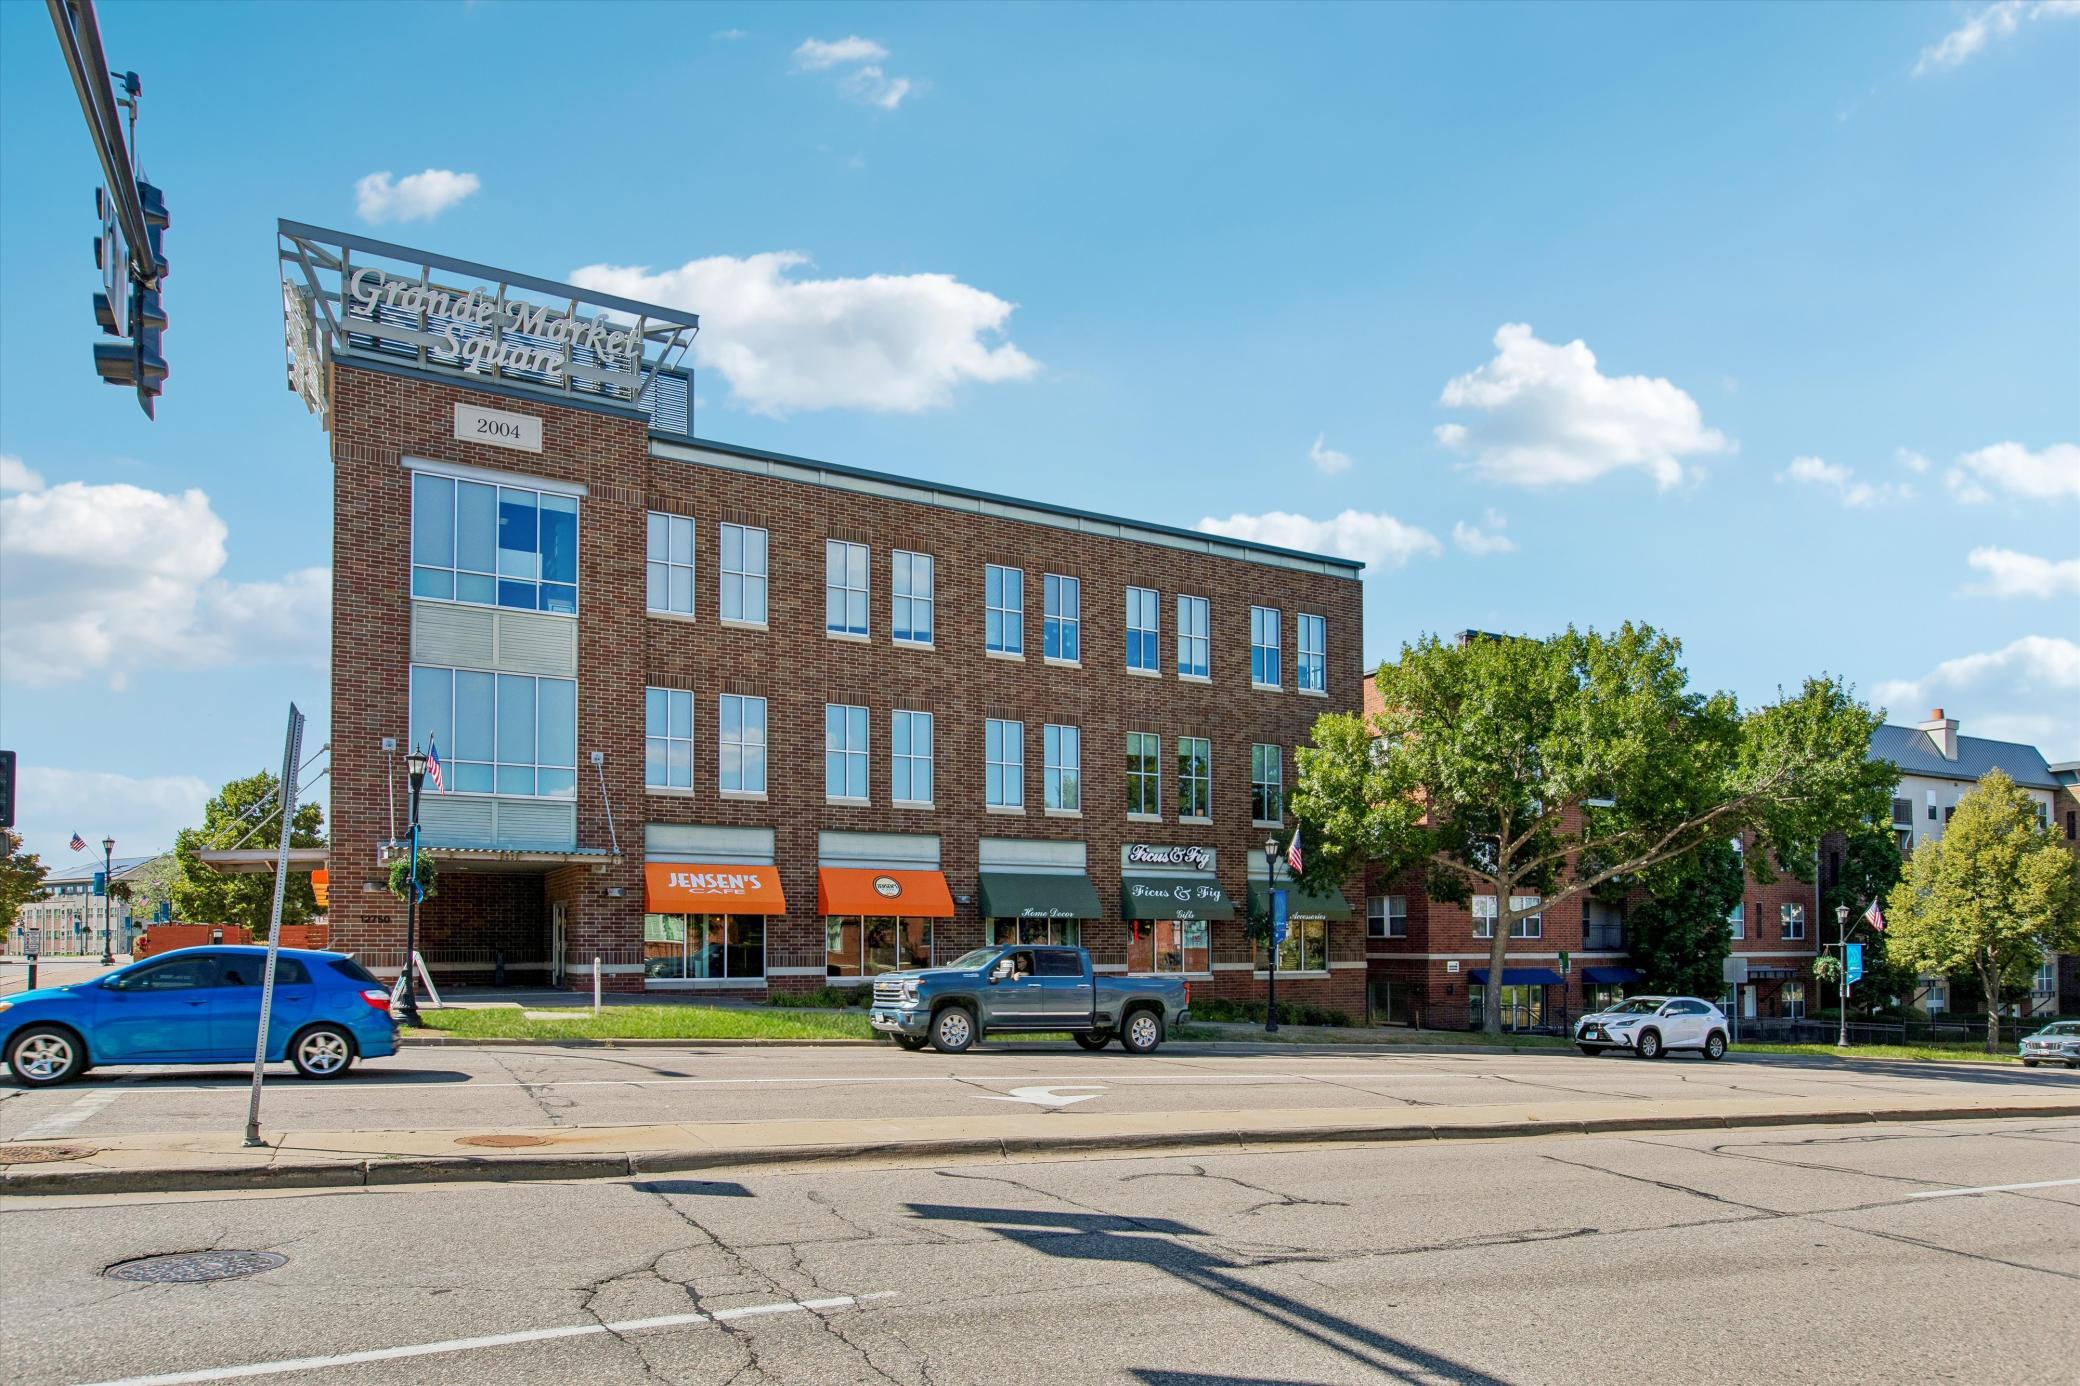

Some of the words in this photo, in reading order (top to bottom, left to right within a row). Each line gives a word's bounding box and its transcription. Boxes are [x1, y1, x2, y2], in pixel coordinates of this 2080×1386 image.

[350, 267, 495, 325] Grande
[503, 300, 645, 361] Market
[434, 322, 565, 376] Square
[477, 418, 521, 439] 2004
[669, 872, 761, 889] JENSEN'S
[1132, 885, 1169, 898] Ficus
[1174, 885, 1192, 901] &
[1197, 886, 1221, 902] Fig
[1021, 907, 1048, 918] Home
[1049, 908, 1075, 918] Decor
[1176, 909, 1194, 919] Gifts
[1289, 912, 1326, 920] Accessories
